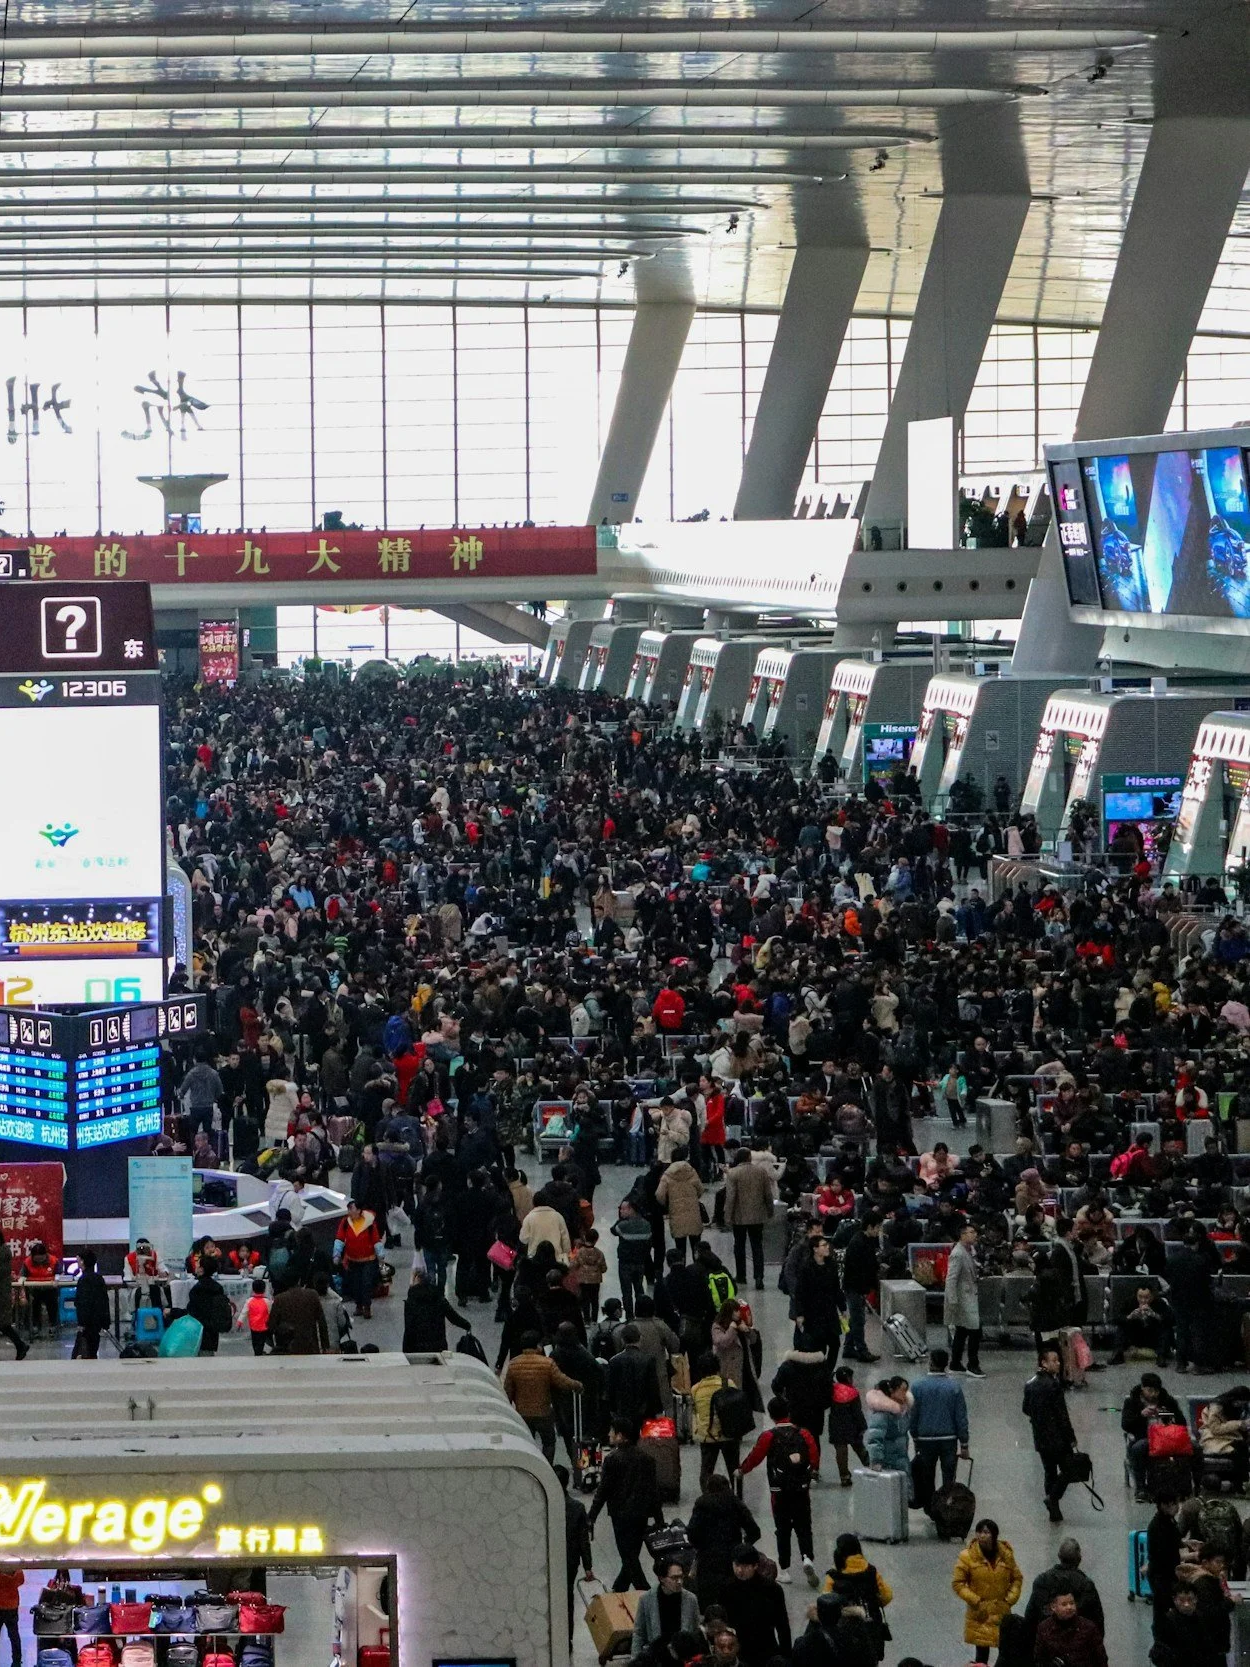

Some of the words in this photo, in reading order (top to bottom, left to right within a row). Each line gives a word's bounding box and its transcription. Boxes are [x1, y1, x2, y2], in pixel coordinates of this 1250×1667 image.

[124, 638, 144, 659] 东
[62, 681, 127, 697] 12306
[880, 725, 918, 733] Hisens
[1125, 776, 1181, 787] Hisense
[9, 921, 147, 943] 杭州东站欢迎您
[216, 1526, 324, 1554] 旅行用品
